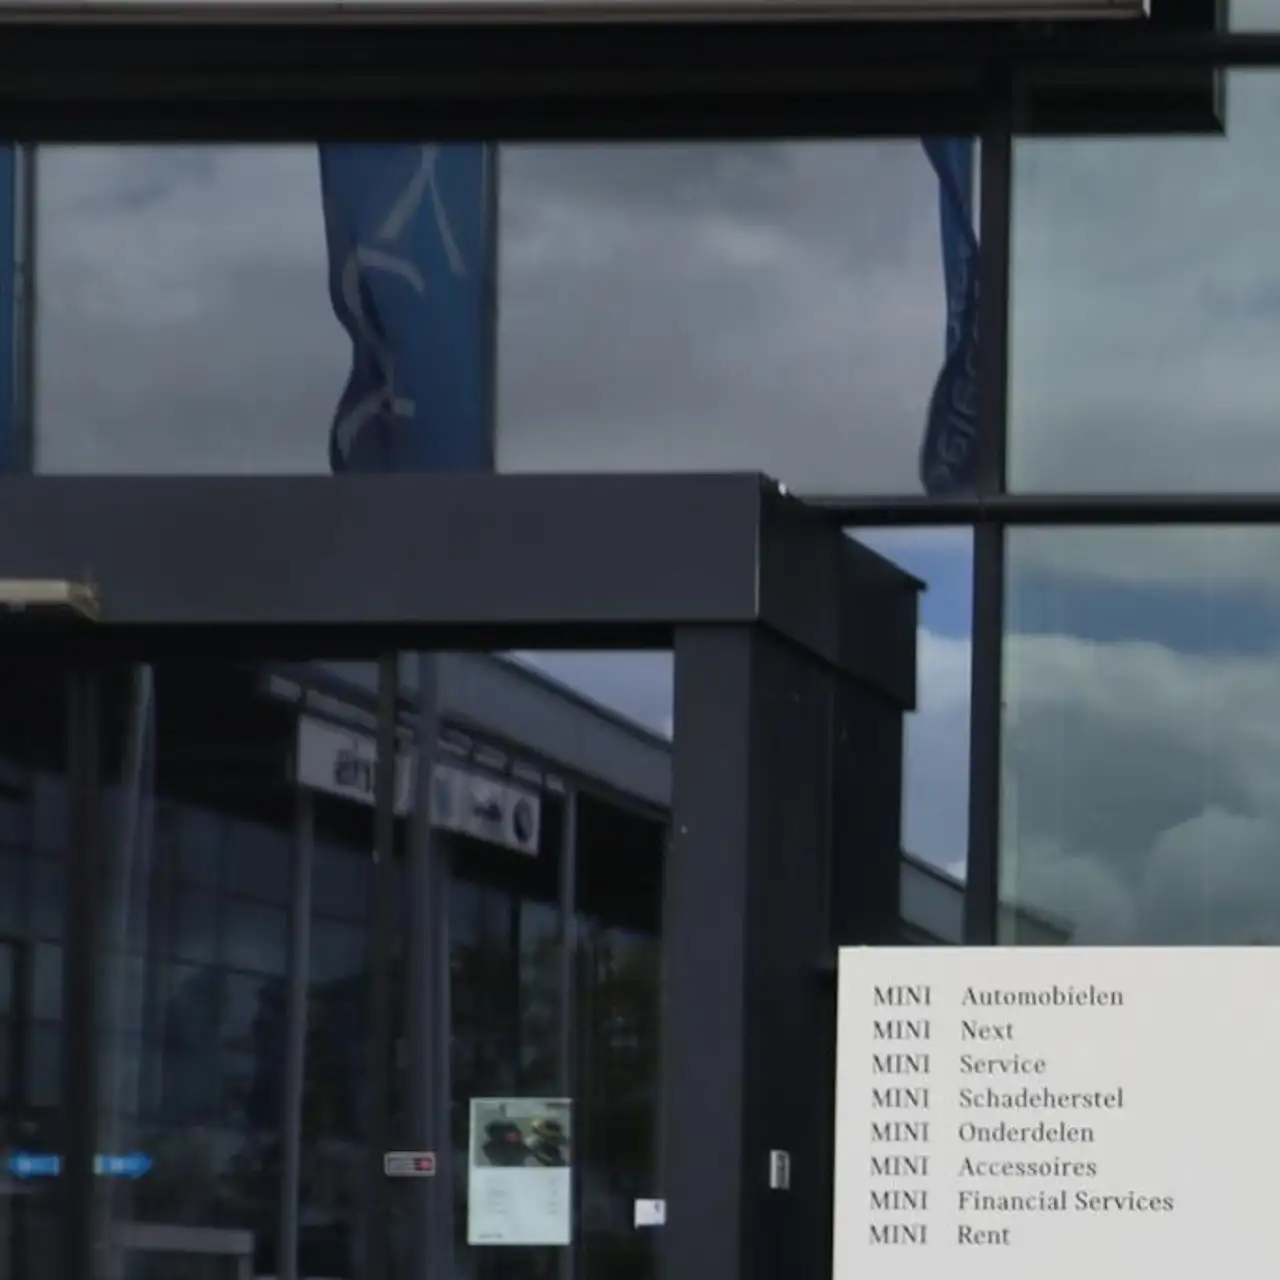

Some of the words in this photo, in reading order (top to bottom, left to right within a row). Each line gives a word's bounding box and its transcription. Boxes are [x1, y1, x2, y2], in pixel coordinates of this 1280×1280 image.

[873, 985, 932, 1007] MINI
[961, 985, 1124, 1007] Automobielen
[873, 1020, 931, 1041] MINI
[960, 1020, 1014, 1041] Next
[872, 1054, 930, 1075] MINI
[959, 1054, 1047, 1075] Service
[871, 1087, 930, 1109] MINI
[959, 1087, 1124, 1110] Schadeherstel
[871, 1121, 929, 1143] MINI
[958, 1121, 1095, 1143] Onderdelen
[870, 1156, 929, 1177] MINI
[958, 1156, 1097, 1178] Accessoires
[869, 1189, 928, 1211] MINI
[958, 1190, 1067, 1211] Financial
[1074, 1190, 1174, 1212] Services
[868, 1224, 928, 1245] MINI
[958, 1224, 1011, 1246] Rent
